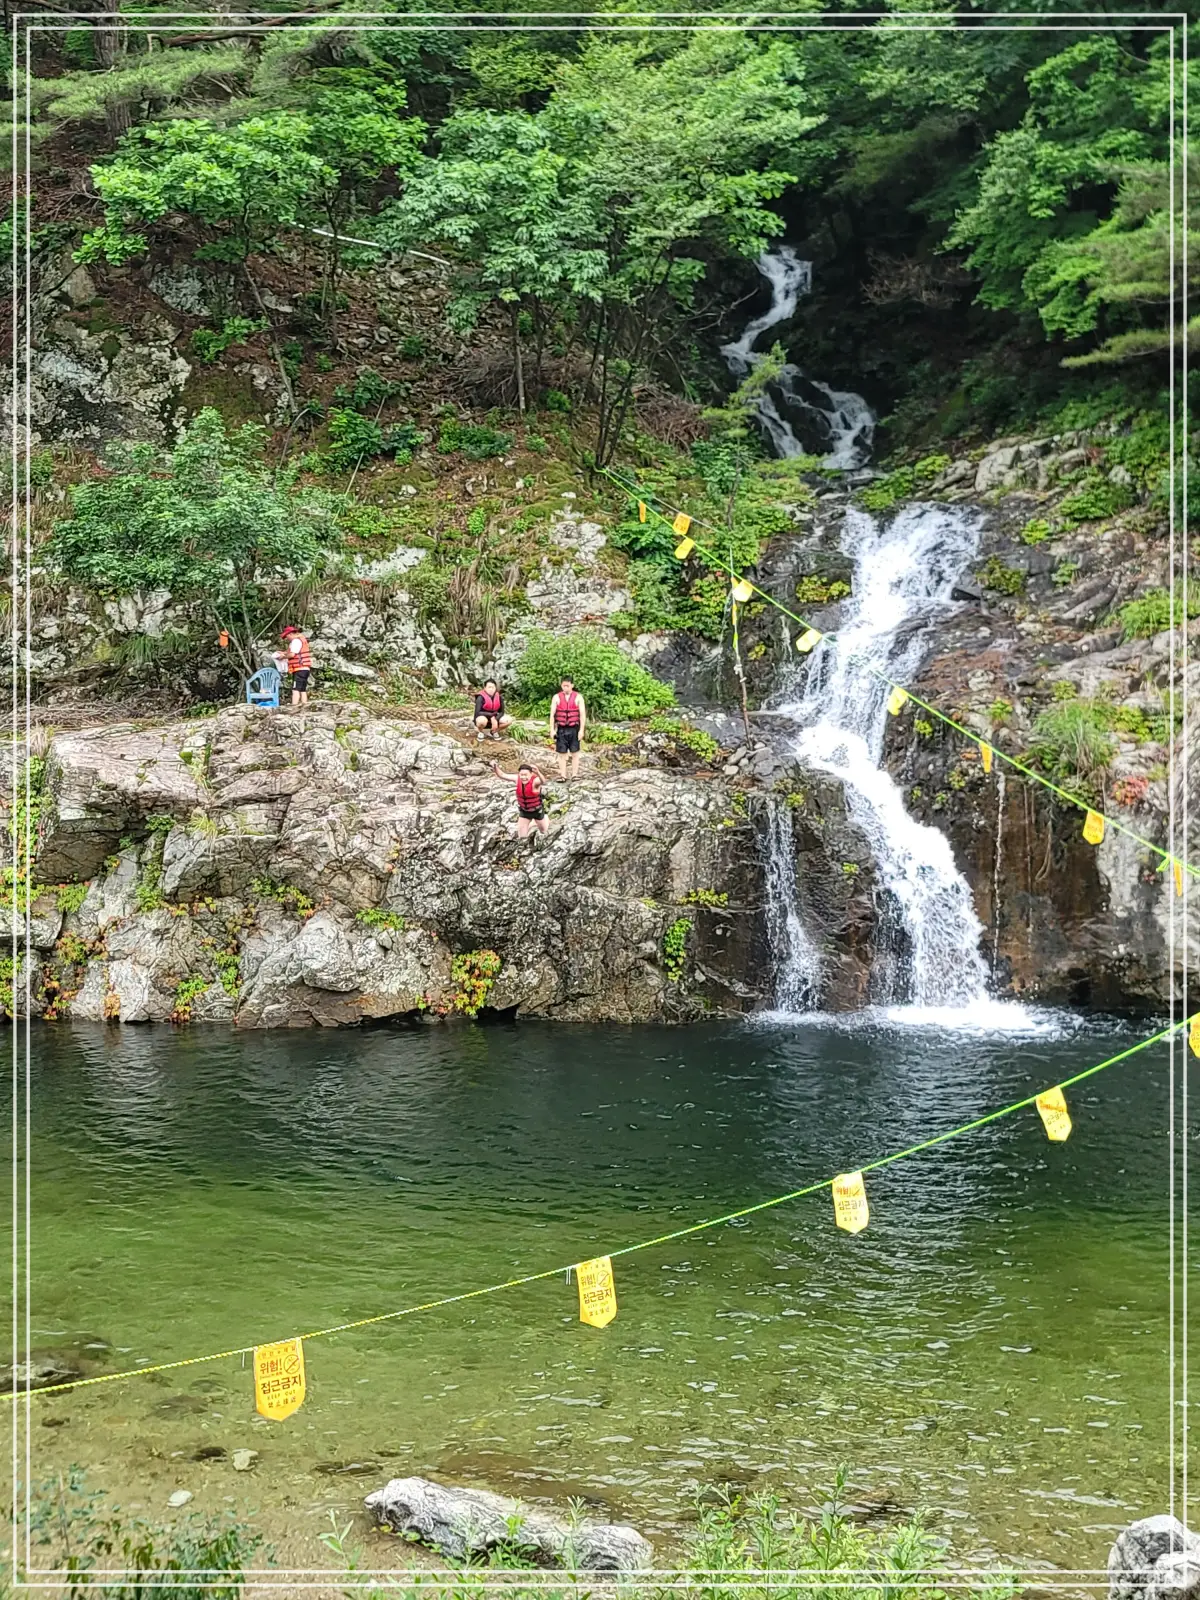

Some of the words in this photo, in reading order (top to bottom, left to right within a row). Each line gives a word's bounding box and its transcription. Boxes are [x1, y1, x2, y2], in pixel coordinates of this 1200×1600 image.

[583, 1288, 613, 1304] 접근금지
[260, 1358, 282, 1374] 위험!
[260, 1374, 302, 1394] 접근금지
